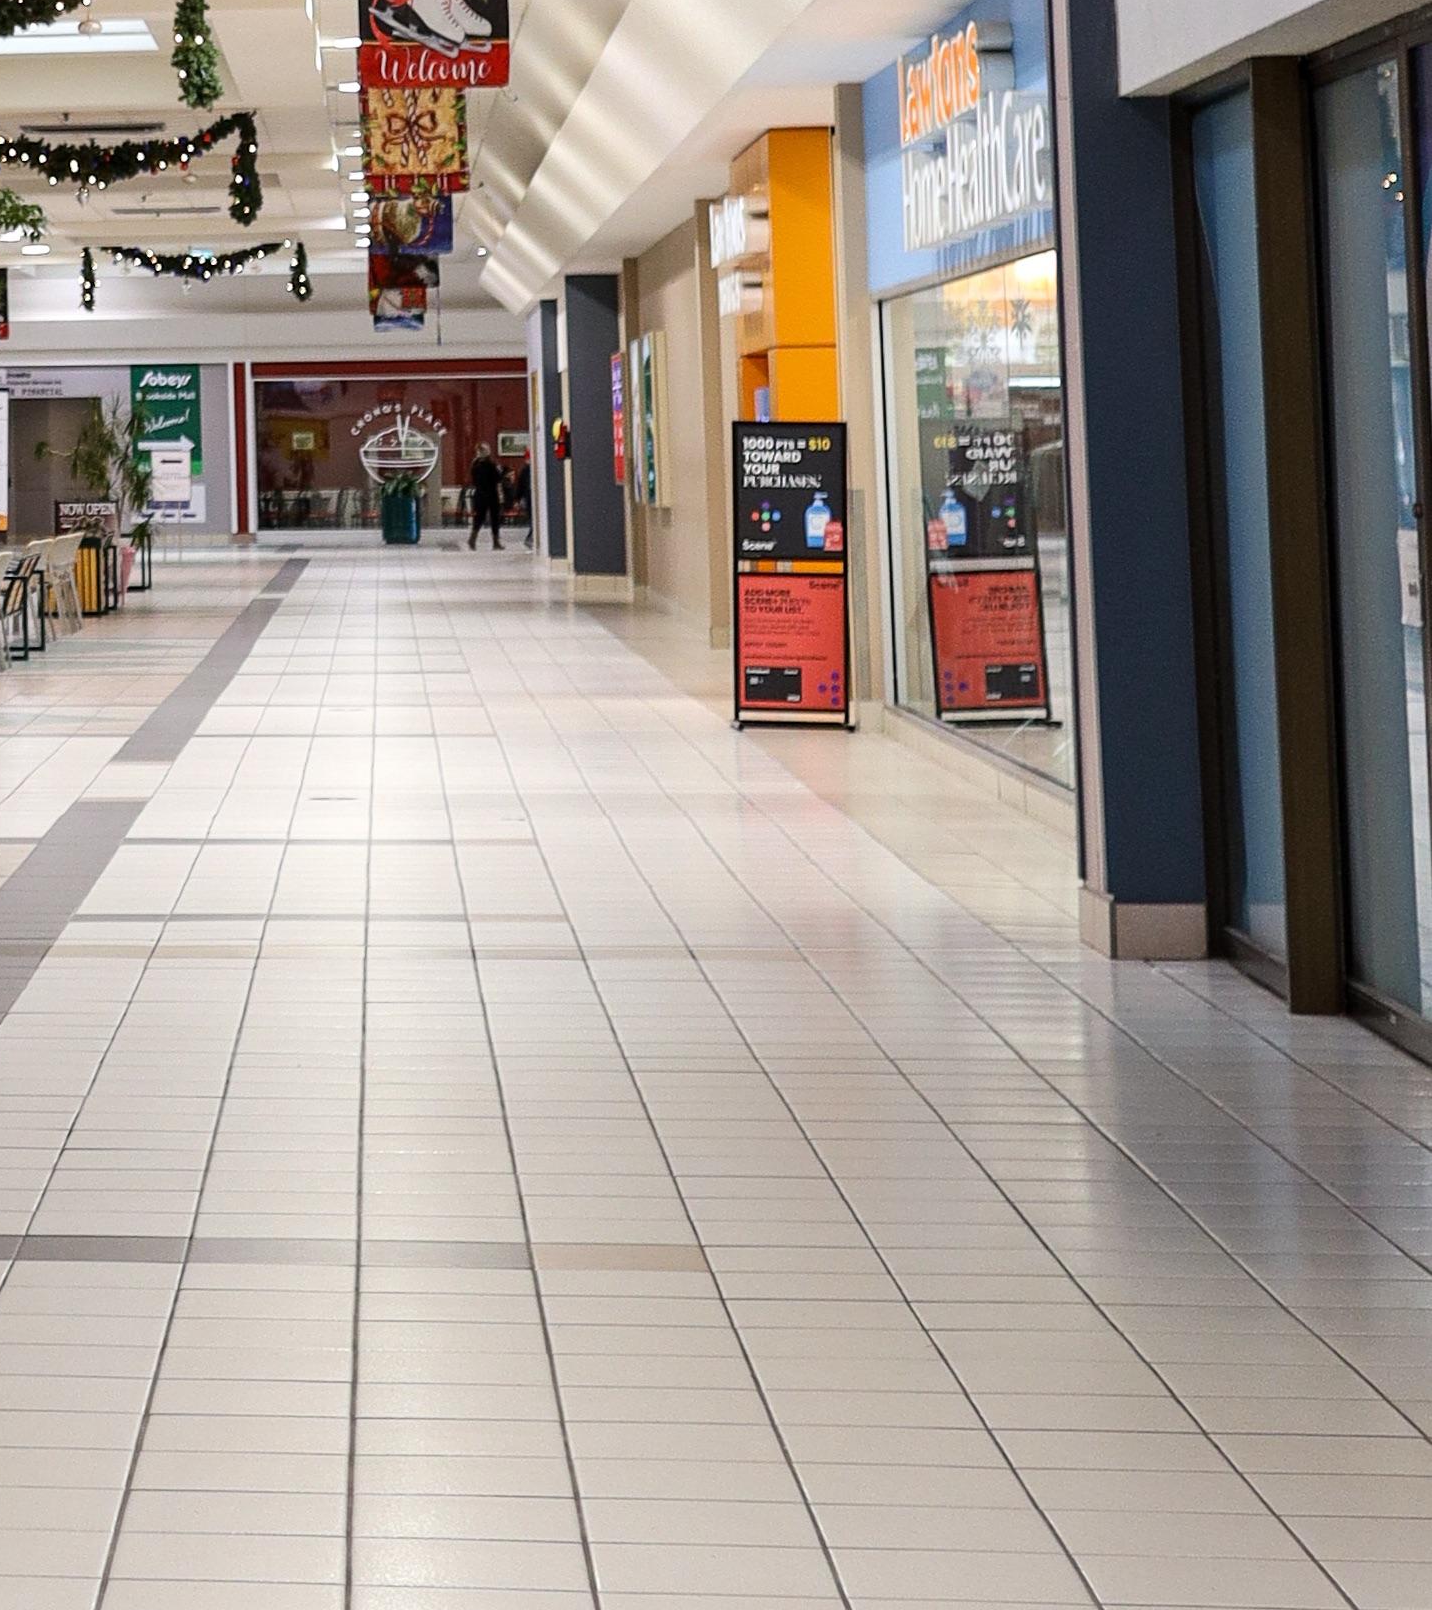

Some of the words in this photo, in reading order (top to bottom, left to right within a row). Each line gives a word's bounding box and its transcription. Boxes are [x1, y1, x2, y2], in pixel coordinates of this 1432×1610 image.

[374, 46, 492, 85] Welcome
[897, 20, 980, 148] Lawtons
[139, 371, 192, 389] Sobeys
[742, 436, 774, 450] 1000
[808, 436, 832, 452] $10
[742, 450, 802, 463] TOWARD
[743, 463, 780, 476] YOUR
[59, 503, 85, 516] NOW
[86, 502, 116, 516] OPEN
